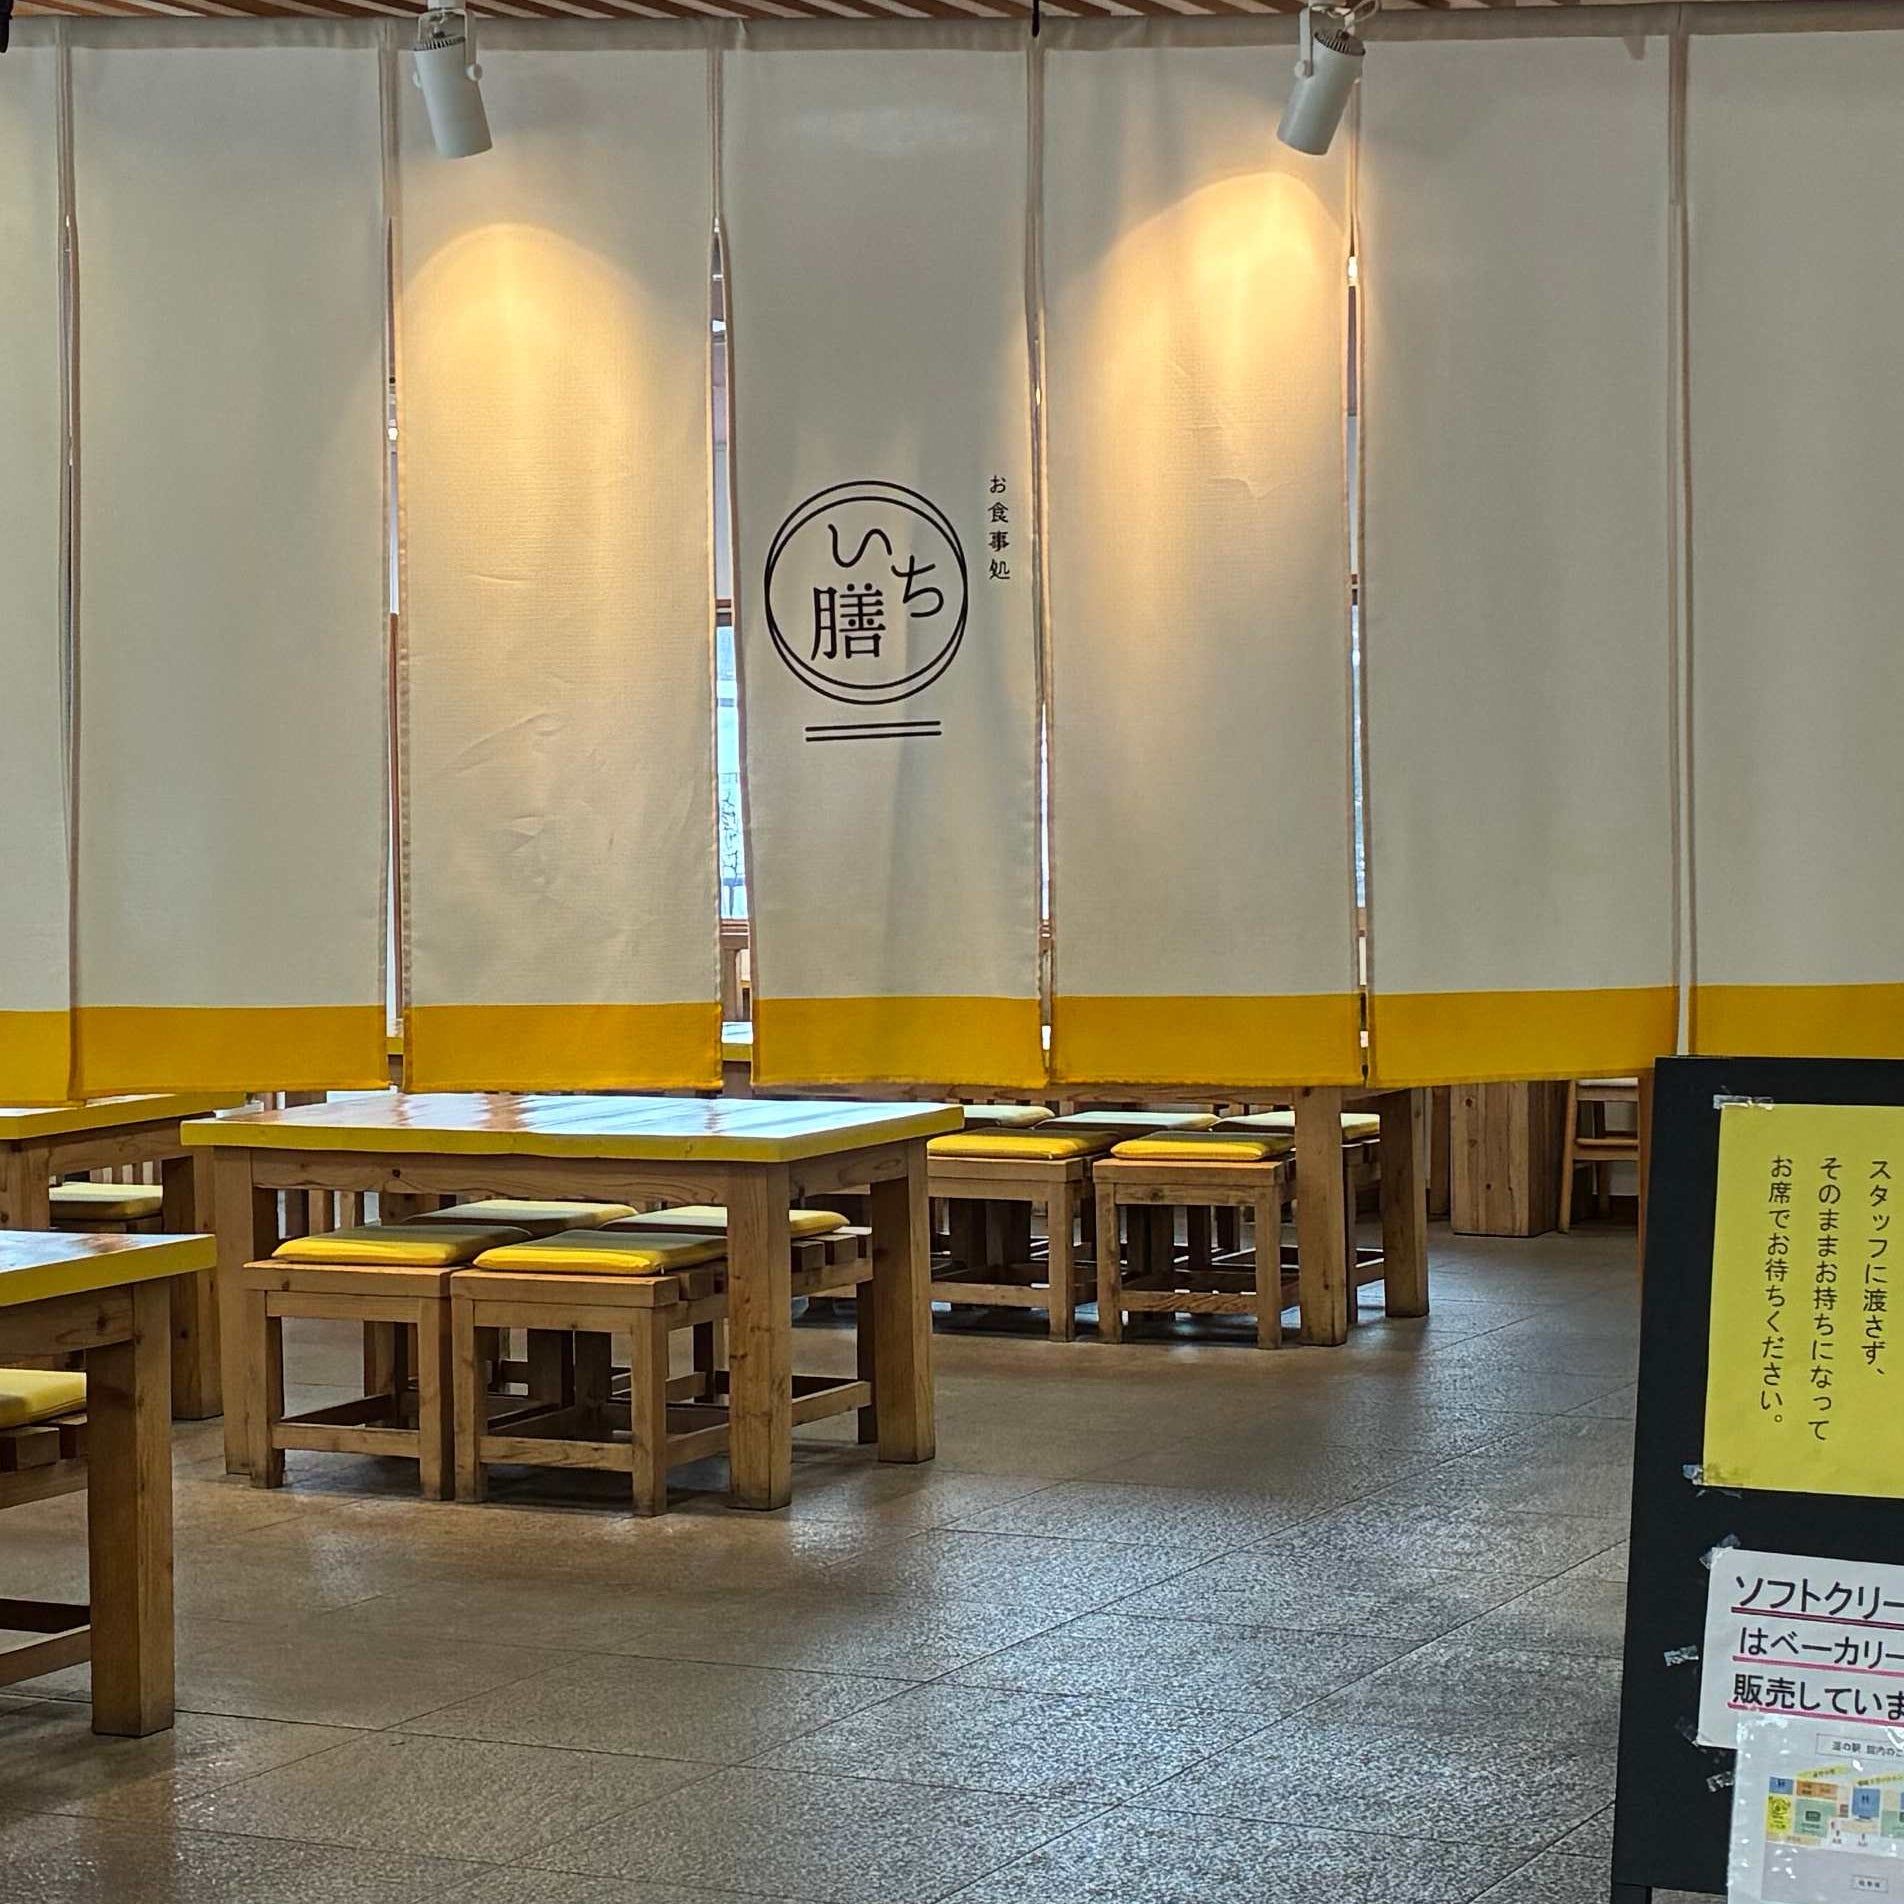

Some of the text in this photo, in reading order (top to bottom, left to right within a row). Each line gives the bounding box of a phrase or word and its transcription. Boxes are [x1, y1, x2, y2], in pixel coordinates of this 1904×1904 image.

[810, 523, 945, 661] いち膳
[988, 474, 1011, 581] お食事処
[1760, 1154, 1793, 1423] お席でお待ちください。
[1808, 1156, 1843, 1441] そのままお持ちになって
[1860, 1160, 1892, 1376] スタッフに渡さず、
